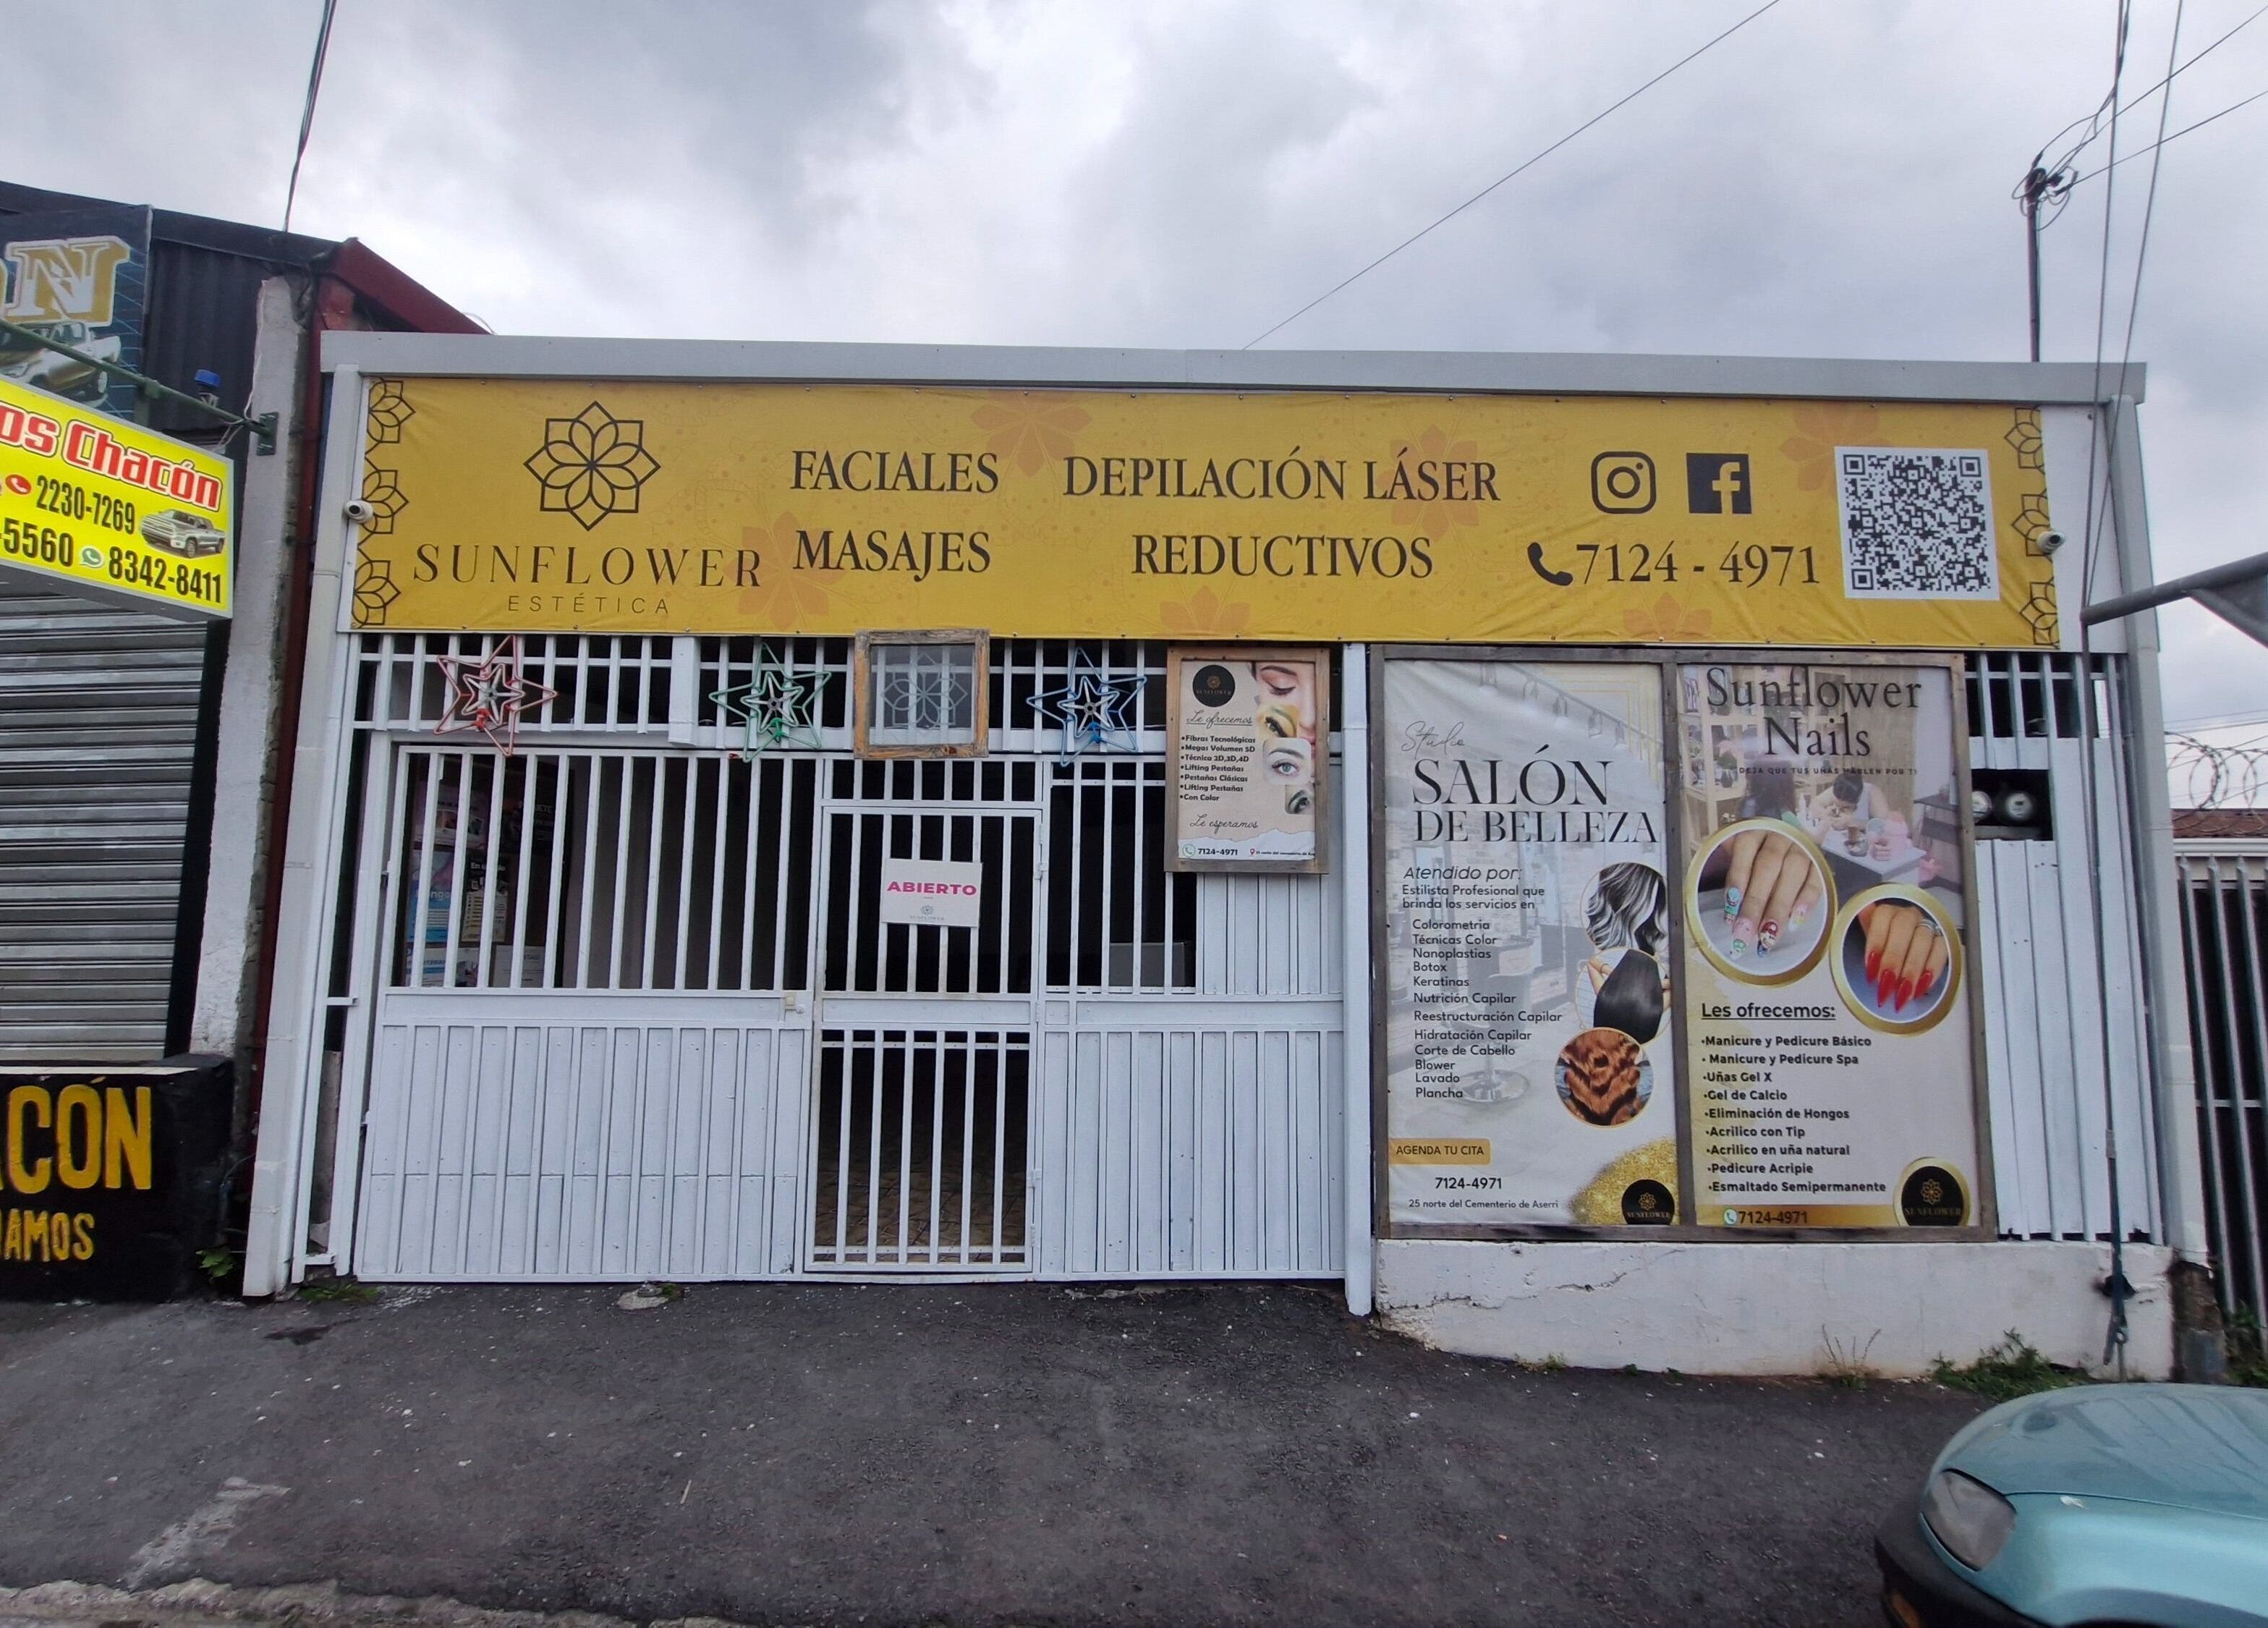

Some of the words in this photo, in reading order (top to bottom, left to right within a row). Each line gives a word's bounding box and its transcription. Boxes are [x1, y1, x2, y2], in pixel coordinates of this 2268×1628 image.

[0, 235, 130, 327] N
[62, 419, 223, 512] Chacón
[790, 449, 999, 493] FACIALES
[1062, 446, 1347, 501] DEPILACIÓN
[1363, 446, 1502, 501] LÁSER
[36, 474, 135, 535] 2230-7269
[793, 528, 992, 582] MASAJES
[1130, 534, 1434, 579] REDUCTIVOS
[413, 543, 761, 588] SUNFLOWER
[1576, 540, 1678, 585] 7124
[1719, 541, 1819, 587] 4971
[109, 546, 221, 603] 8342-8411
[509, 593, 669, 614] ESTÉTICA
[1707, 666, 1921, 709] Sunflower
[1186, 709, 1204, 722] Le
[1206, 712, 1252, 729] ofrecemos
[1764, 712, 1871, 757] Nails
[1413, 745, 1613, 805] SALÓN
[1190, 814, 1207, 826] Le
[1209, 820, 1259, 834] esperamos
[1413, 810, 1468, 842] DE
[1482, 810, 1660, 843] BELLEZA
[1403, 866, 1482, 880] Atendido
[887, 881, 977, 896] ABIERTO
[1402, 885, 1448, 895] Estilista
[1453, 884, 1519, 896] Profesional
[1523, 887, 1545, 898] que
[1402, 898, 1442, 909] brinda
[1445, 898, 1461, 909] los
[1466, 899, 1516, 909] servicios
[1413, 934, 1461, 945] Técnicas
[1466, 934, 1498, 945] Color
[1414, 948, 1491, 960] Nanoplastias
[1414, 962, 1447, 972] Botox
[1414, 976, 1469, 987] Keratinas
[1414, 993, 1469, 1004] Nutrición
[1472, 993, 1516, 1006] Capilar
[1702, 1003, 1731, 1017] Les
[1736, 1003, 1835, 1018] ofrecemos:
[1414, 1011, 1514, 1022] Reestructuración
[1518, 1011, 1563, 1024] Capilar
[1415, 1029, 1484, 1040] Hidratación
[1488, 1030, 1532, 1043] Capilar
[1705, 1035, 1762, 1046] Manicure
[1765, 1038, 1772, 1048] y
[1775, 1035, 1828, 1046] Pedicure
[1832, 1035, 1872, 1046] Básico
[1415, 1045, 1448, 1055] Corte
[1452, 1045, 1466, 1055] de
[1470, 1045, 1516, 1056] Cabello
[1416, 1059, 1456, 1070] Blower
[1710, 1053, 1766, 1064] Manicure
[1770, 1056, 1776, 1066] y
[1780, 1053, 1832, 1064] Pedicure
[1836, 1054, 1859, 1067] Spa
[1416, 1072, 1460, 1083] Lavado
[1707, 1072, 1737, 1082] Uñas
[1741, 1072, 1760, 1082] Gel
[1764, 1072, 1772, 1082] X
[1416, 1088, 1463, 1098] Plancha
[1708, 1090, 1728, 1100] Gel
[1731, 1090, 1746, 1100] de
[1750, 1090, 1787, 1100] Calcio
[1710, 1108, 1782, 1119] Eliminación
[1786, 1108, 1800, 1118] de
[1804, 1108, 1849, 1121] Hongos
[0, 1076, 152, 1195] CÓN
[1785, 1127, 1805, 1139] Tip
[1396, 1145, 1441, 1155] AGENDA
[1444, 1145, 1458, 1155] TU
[1461, 1145, 1485, 1156] CITA
[1780, 1145, 1802, 1155] uña
[1806, 1145, 1850, 1156] natural
[1712, 1163, 1766, 1173] Pedicure
[1435, 1177, 1503, 1190] 7124-4971
[1712, 1182, 1778, 1192] Esmaltado
[1781, 1182, 1886, 1194] Semipermanente
[1409, 1199, 1420, 1208] 25
[1465, 1200, 1516, 1208] Cementerio
[1519, 1200, 1530, 1208] de
[1739, 1211, 1807, 1224] 7124-4971
[0, 1208, 95, 1263] AMOS
